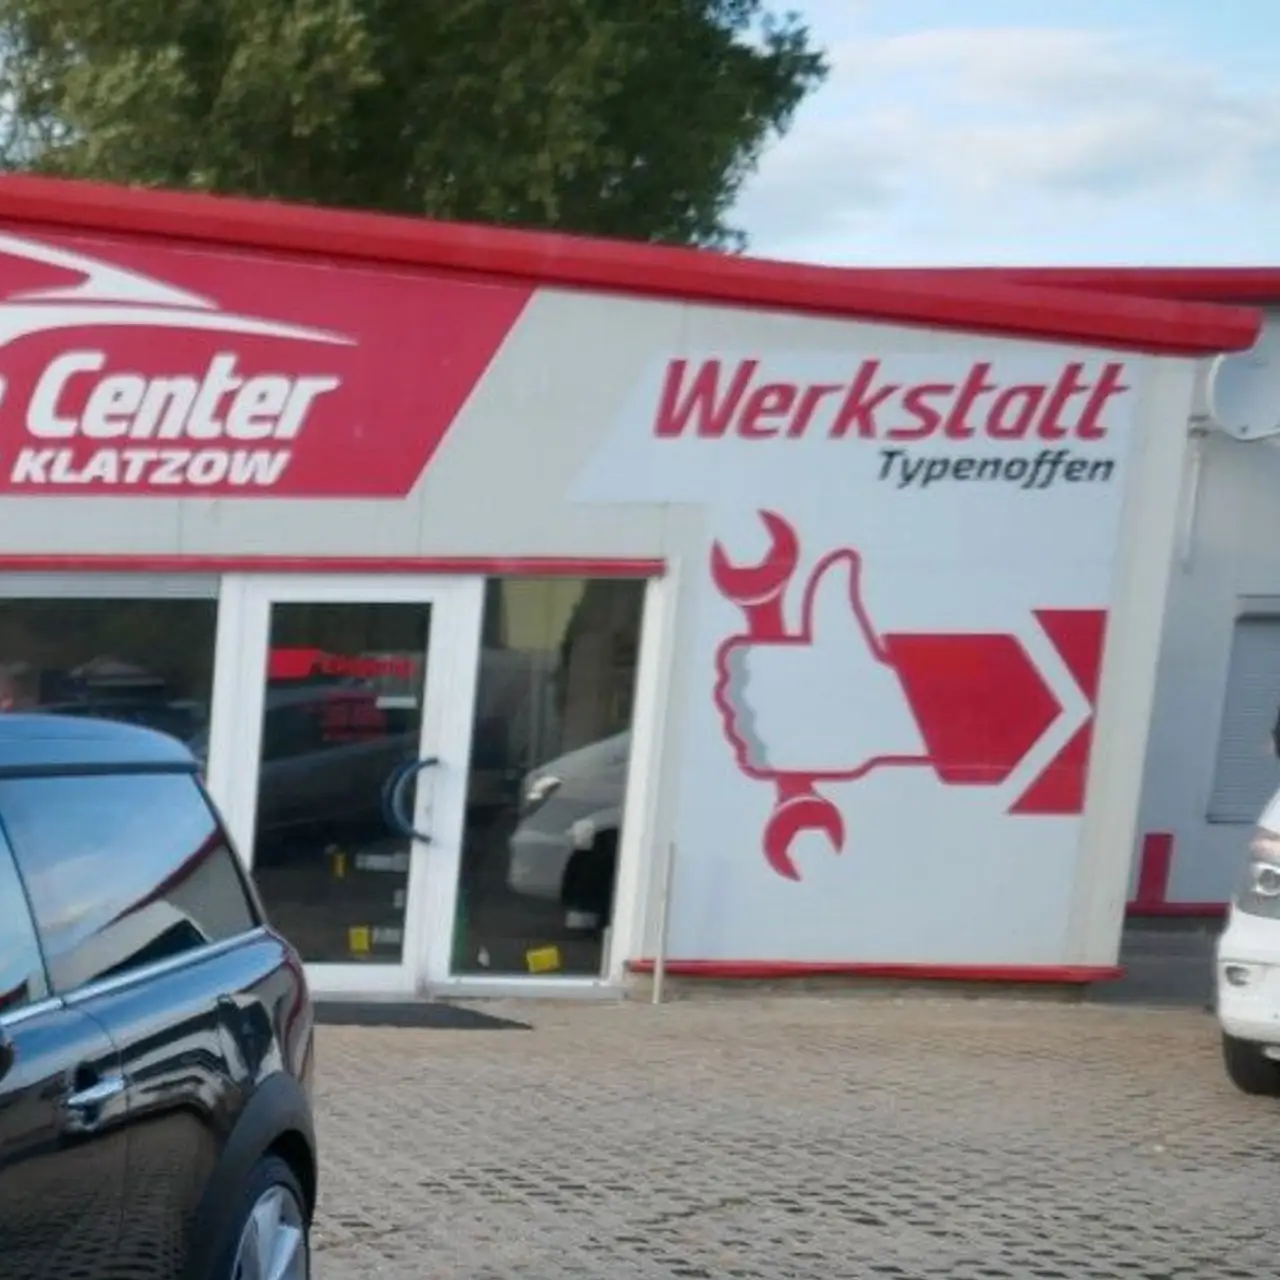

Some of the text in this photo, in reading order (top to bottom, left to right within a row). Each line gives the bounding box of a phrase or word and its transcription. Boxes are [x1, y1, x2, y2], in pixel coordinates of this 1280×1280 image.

[25, 349, 342, 441] Center
[653, 358, 1131, 441] Werkstatt
[10, 447, 292, 487] KLATZOW
[877, 448, 1115, 490] Typenoffen
